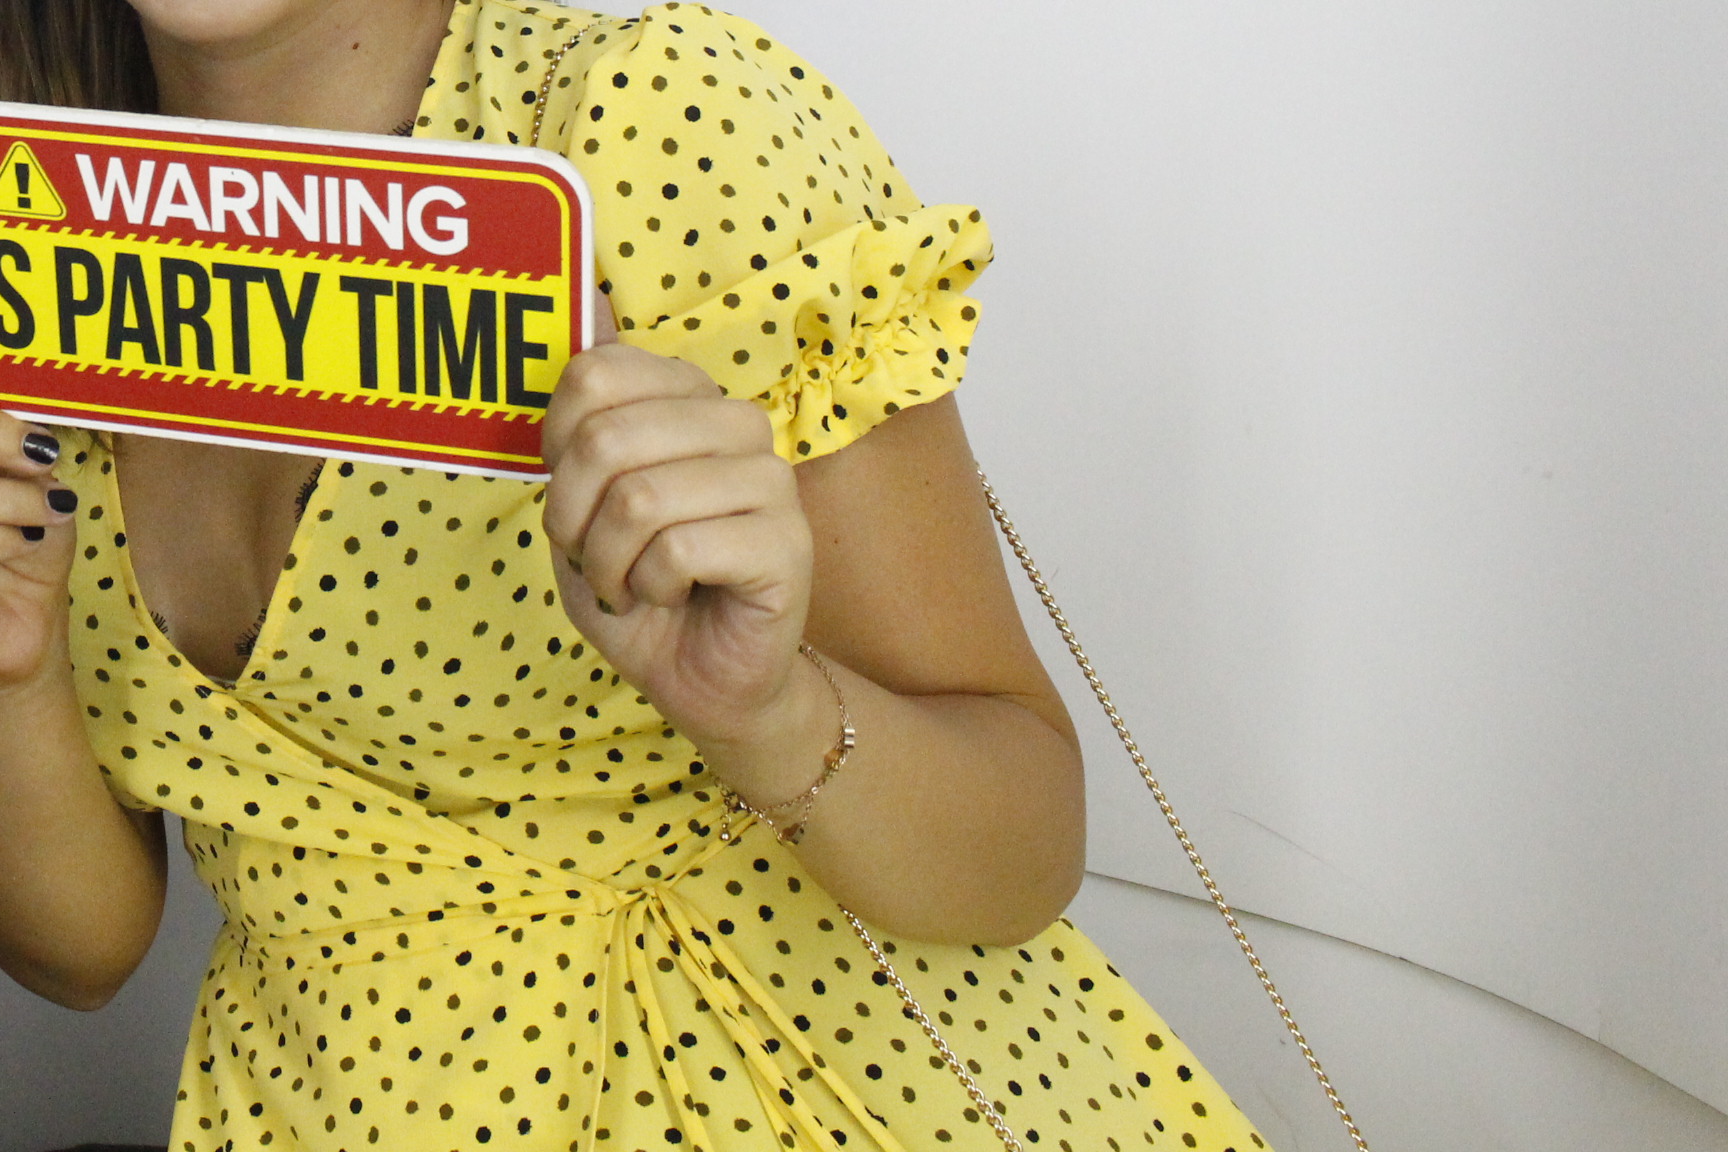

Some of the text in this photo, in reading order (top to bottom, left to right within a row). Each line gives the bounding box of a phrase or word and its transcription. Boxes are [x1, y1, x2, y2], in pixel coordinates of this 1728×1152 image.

[75, 153, 468, 256] WARNING
[54, 246, 320, 381] PARTY
[339, 275, 554, 409] TIME
